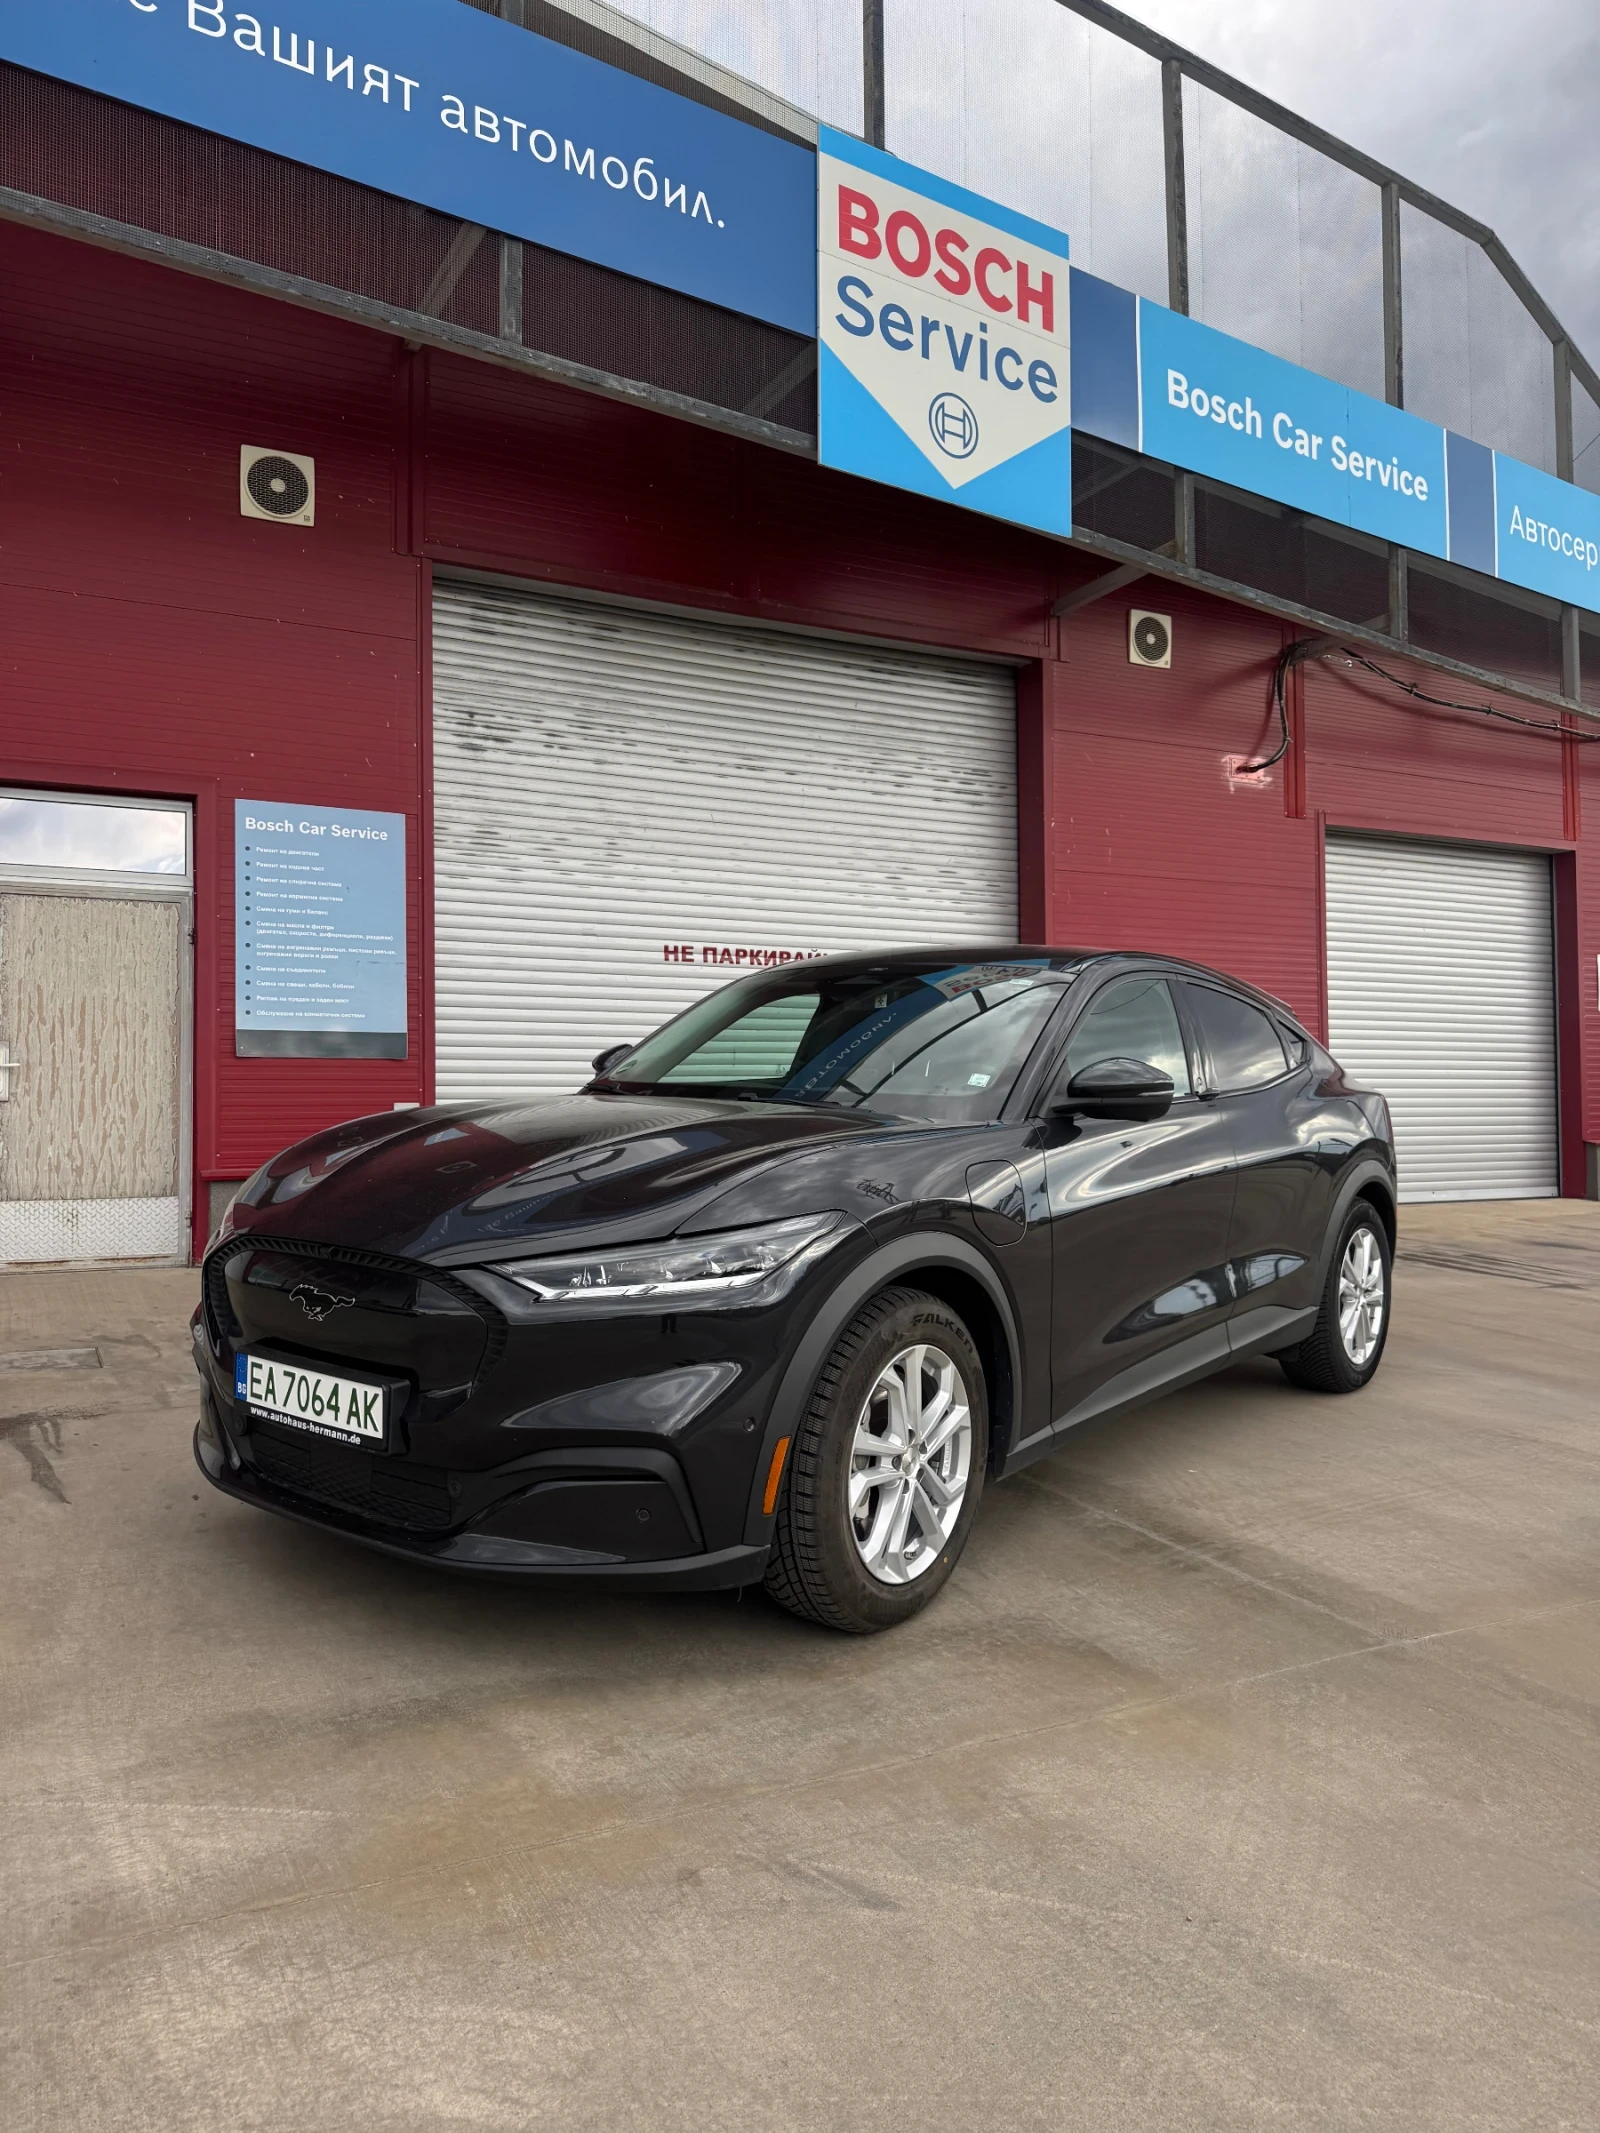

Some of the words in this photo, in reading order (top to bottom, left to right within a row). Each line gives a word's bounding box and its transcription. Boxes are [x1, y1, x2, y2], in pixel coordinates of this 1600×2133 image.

[187, 0, 420, 112] Вашият
[440, 93, 726, 228] автомобил.
[838, 184, 1055, 332] BOSCH
[835, 275, 1058, 404] Service
[1166, 369, 1263, 440] Bosch
[1272, 412, 1323, 462] Car
[1331, 438, 1429, 502] Service
[1509, 504, 1600, 572] Автосер
[245, 816, 294, 833] Bosch
[299, 821, 327, 836] Car
[331, 824, 388, 841] Service
[663, 945, 695, 963] НЕ
[237, 1382, 247, 1394] BG
[250, 1406, 361, 1445] www.autohaus-hermann.de
